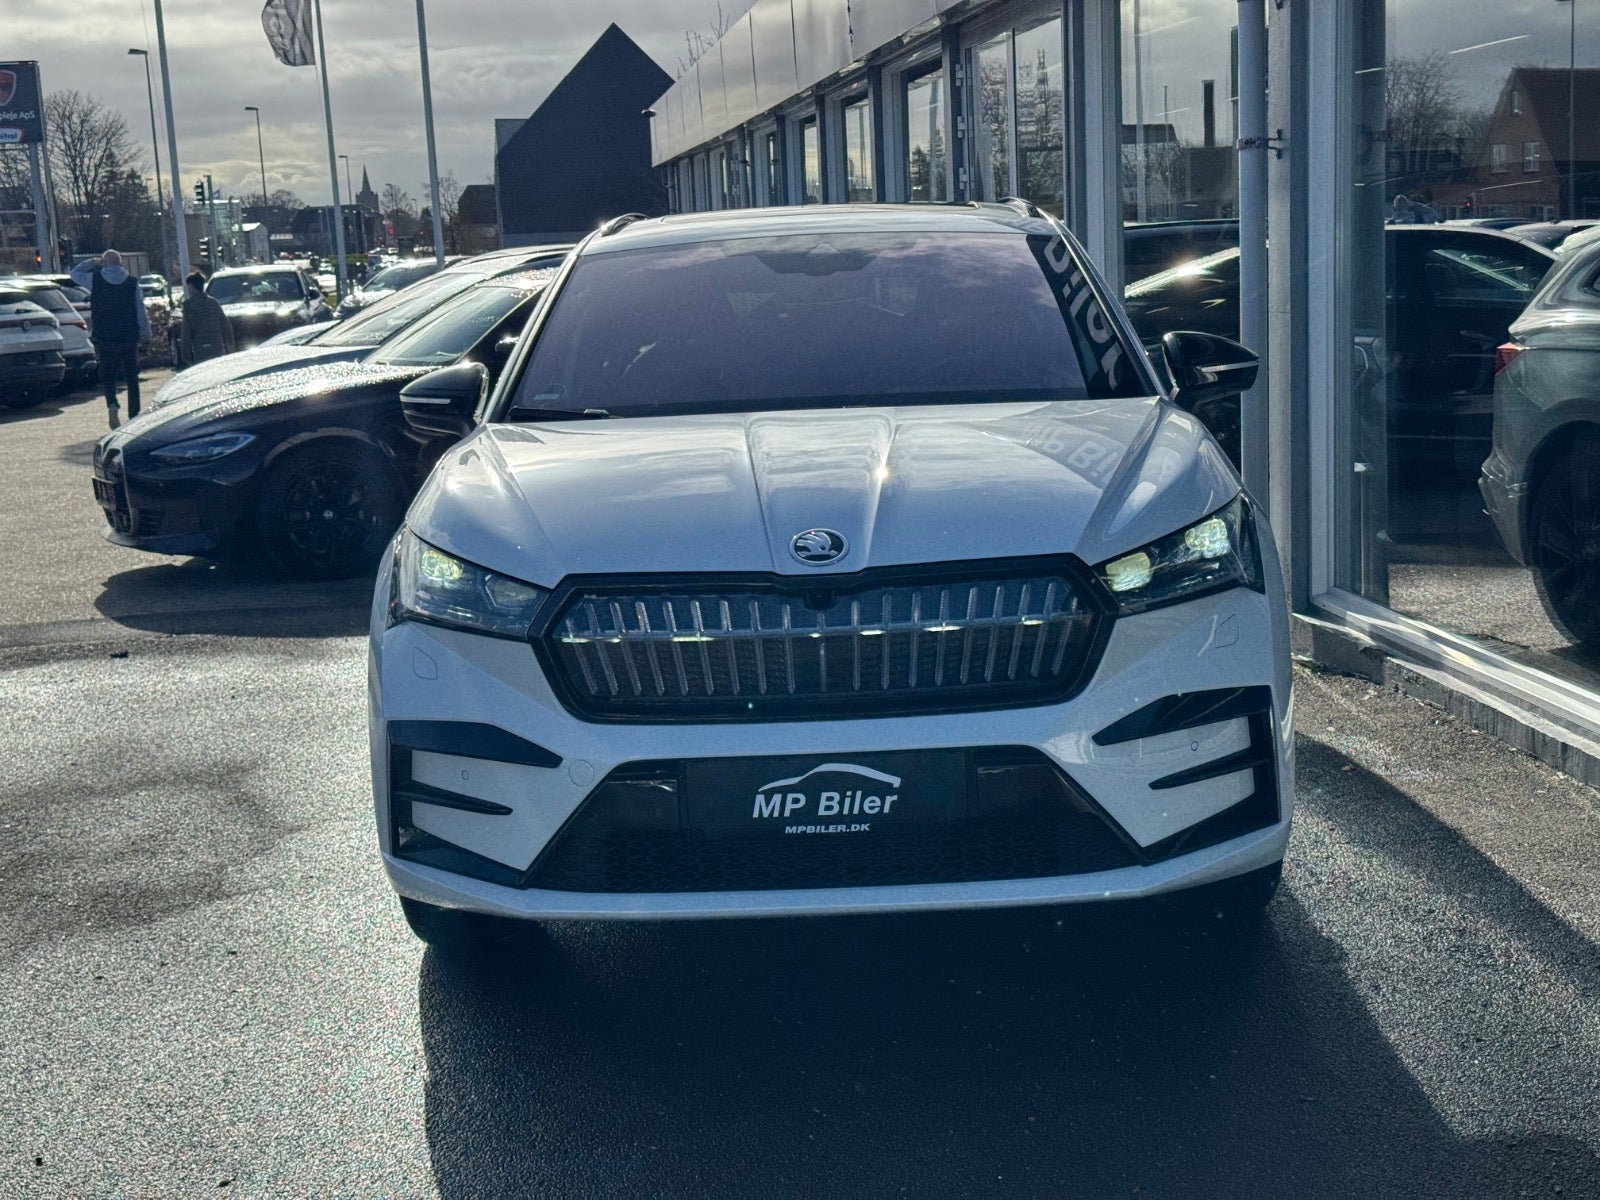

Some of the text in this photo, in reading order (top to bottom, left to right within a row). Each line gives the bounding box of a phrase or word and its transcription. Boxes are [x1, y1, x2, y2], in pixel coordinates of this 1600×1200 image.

[19, 111, 35, 120] ApS
[752, 790, 898, 819] MP Biler
[785, 823, 870, 834] MPBILER.DK
